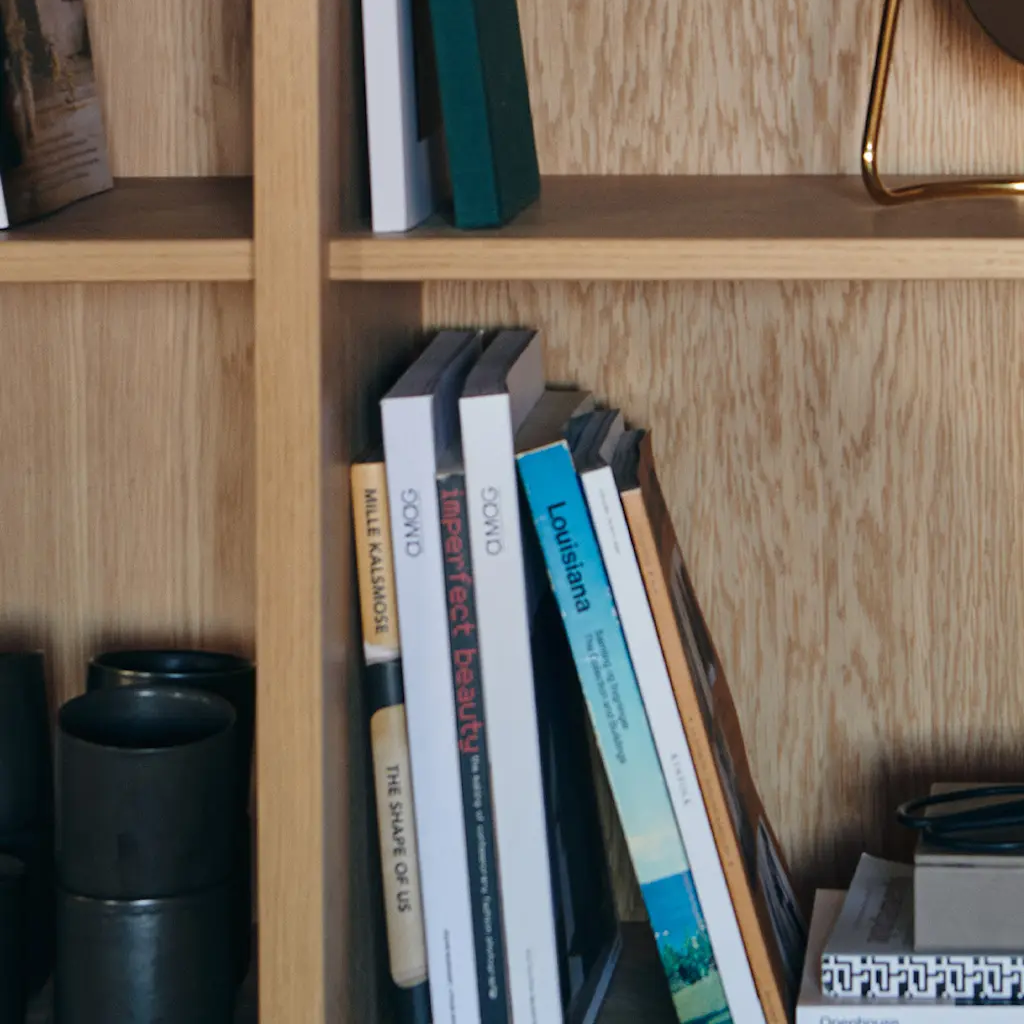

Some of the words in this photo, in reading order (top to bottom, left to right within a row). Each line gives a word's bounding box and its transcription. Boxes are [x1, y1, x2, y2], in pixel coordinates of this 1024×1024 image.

[364, 488, 383, 537] MILLE
[440, 487, 477, 636] imperfect
[547, 500, 592, 614] Louisiana
[369, 542, 390, 636] KALSMOSE
[452, 647, 487, 755] beauty
[385, 763, 403, 796] THE
[387, 800, 407, 857] SHAPE
[394, 861, 410, 886] OF
[396, 890, 413, 914] US
